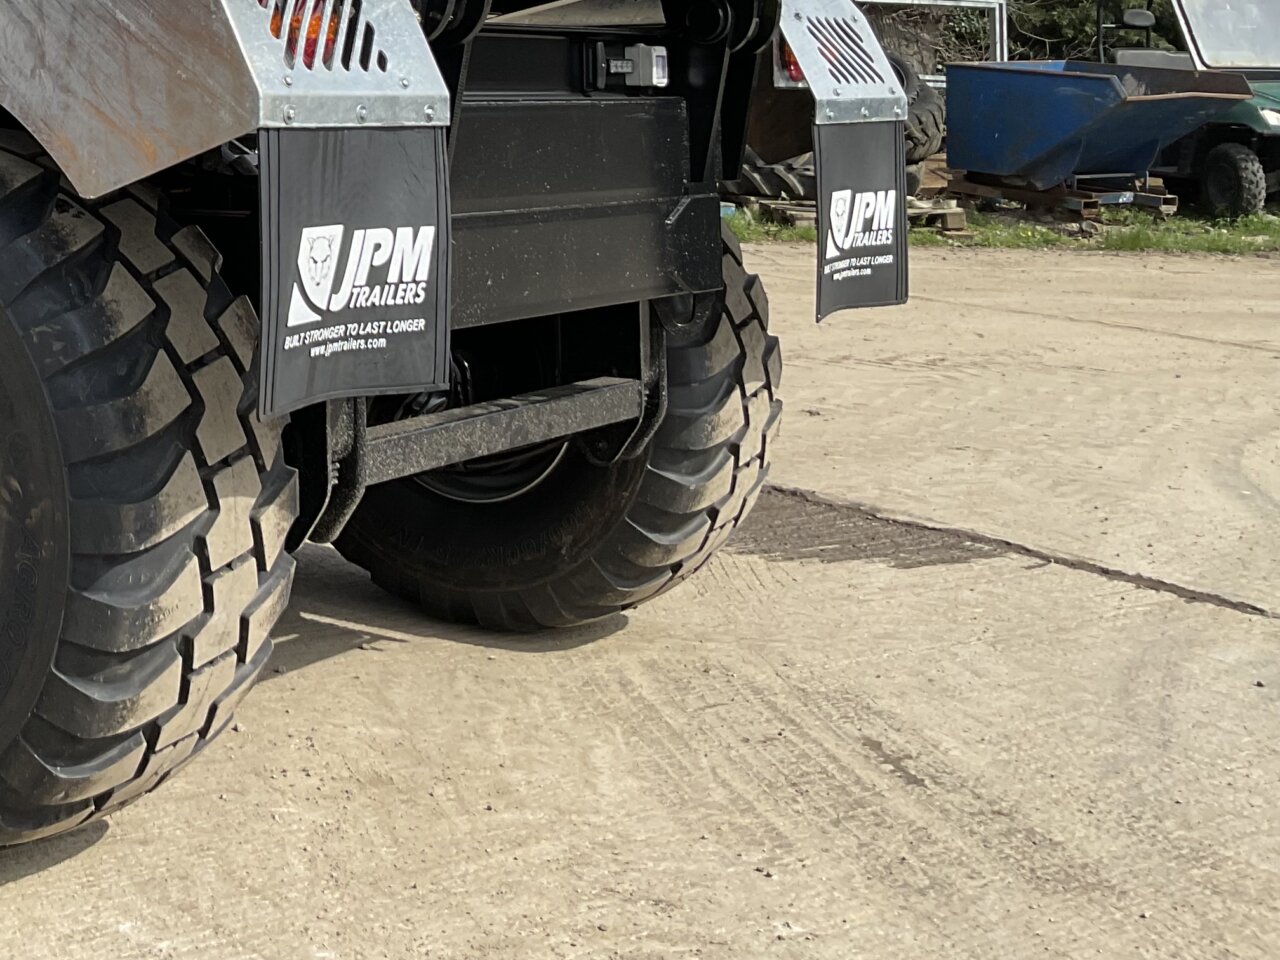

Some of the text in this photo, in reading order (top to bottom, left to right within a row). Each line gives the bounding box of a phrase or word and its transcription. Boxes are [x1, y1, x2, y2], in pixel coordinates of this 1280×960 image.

[843, 190, 896, 249] JPM
[852, 229, 893, 248] TRAILERS
[328, 225, 436, 312] JPM
[856, 256, 871, 266] LAST
[871, 254, 893, 265] LONGER
[349, 282, 427, 309] TRAILERS
[284, 318, 426, 350] BUILT STRONGER TO LAST LONGER
[310, 337, 387, 358] www.jpmtrailers.com
